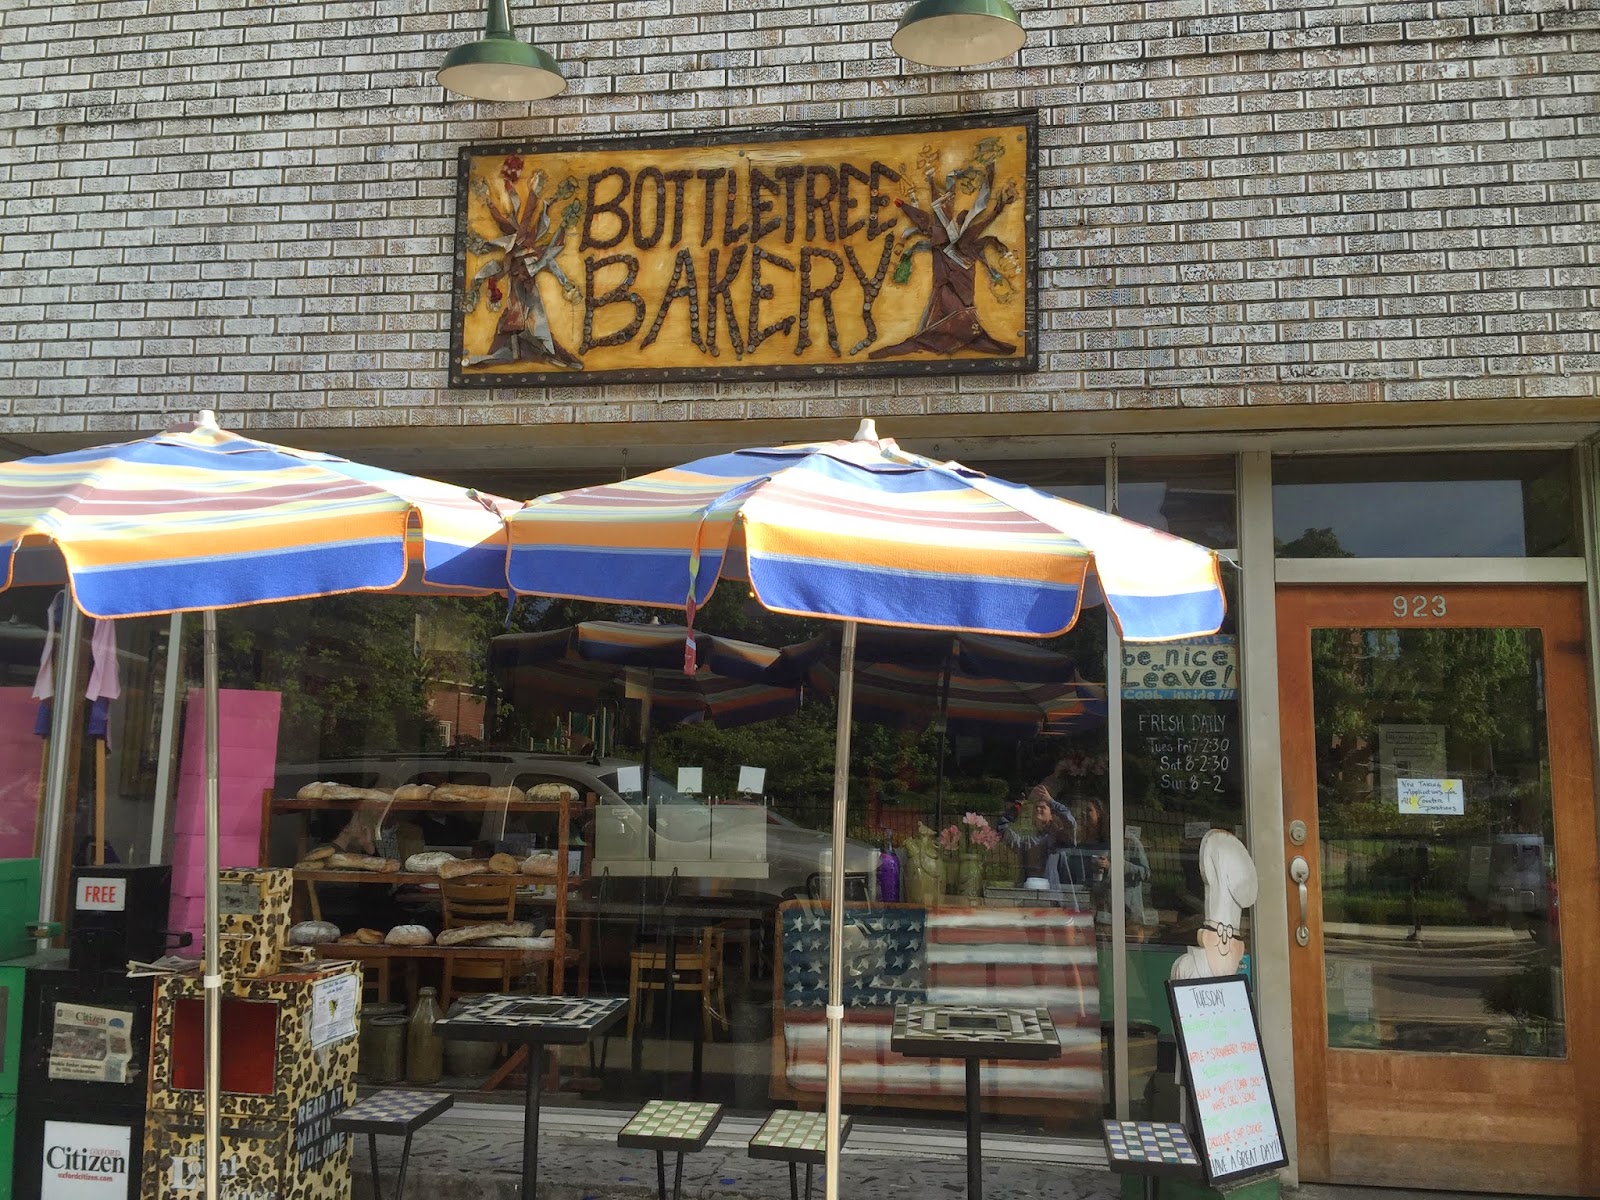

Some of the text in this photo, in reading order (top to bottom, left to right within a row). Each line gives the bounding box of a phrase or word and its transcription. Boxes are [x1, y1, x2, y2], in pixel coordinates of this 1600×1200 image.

[579, 160, 900, 252] BOTTLETREE
[579, 232, 895, 360] BAKERY
[1392, 594, 1448, 618] 923
[1121, 647, 1229, 666] be nice
[1121, 665, 1233, 689] Leave!
[1138, 714, 1226, 733] FRESH DAILY
[84, 885, 116, 904] FREE
[1189, 987, 1226, 1008] TUESDAY
[75, 1012, 107, 1024] Citizen
[297, 1086, 343, 1125] READ AT
[46, 1145, 125, 1174] Citizen
[89, 1148, 121, 1156] OXFORD
[299, 1131, 346, 1172] VOLUME
[1211, 1155, 1228, 1177] HAVE
[1230, 1155, 1236, 1168] A
[1236, 1147, 1257, 1167] GREAT
[57, 1172, 113, 1182] oxfordcitizen.com
